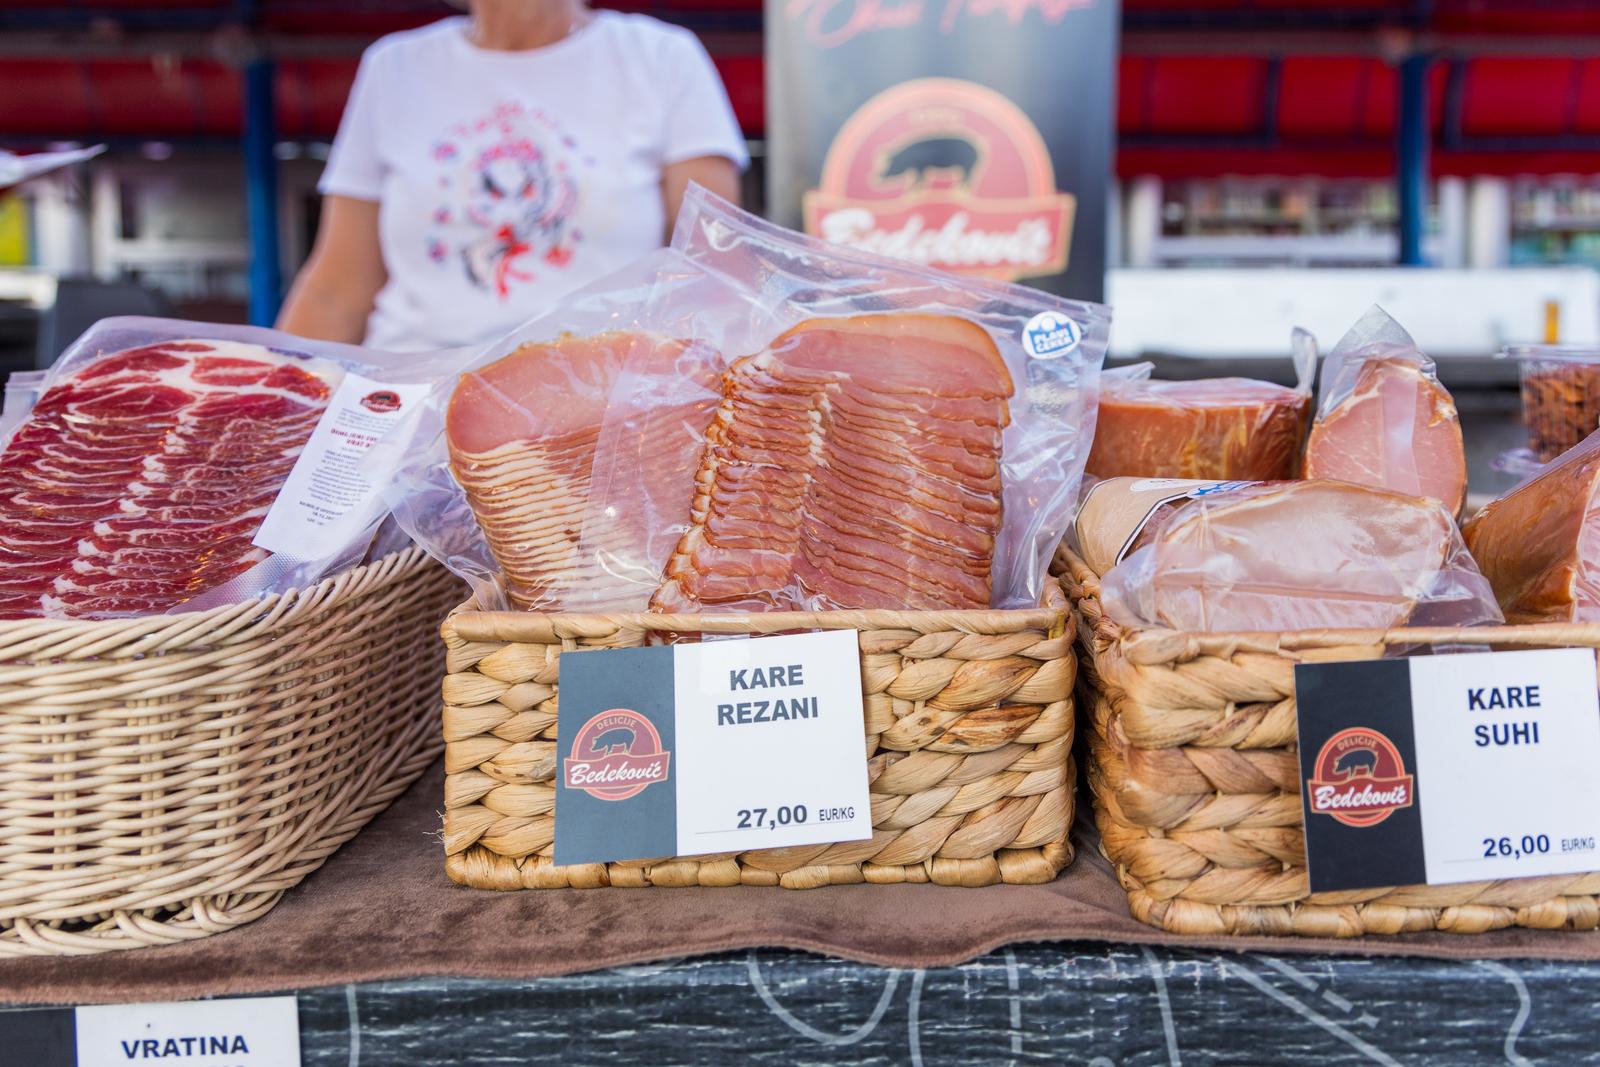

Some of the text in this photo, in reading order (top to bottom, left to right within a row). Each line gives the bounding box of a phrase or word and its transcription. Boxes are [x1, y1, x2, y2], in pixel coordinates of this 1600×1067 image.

[729, 664, 804, 692] KARE
[717, 696, 819, 726] REZANI
[1468, 685, 1541, 711] KARE
[596, 716, 637, 730] DELICIJE
[1474, 722, 1540, 747] SUHI
[1337, 735, 1378, 751] DELICIJE
[570, 761, 662, 785] Bedeković
[1315, 784, 1407, 810] Bedeković
[736, 805, 855, 831] 27,00 EUR/KG
[1483, 834, 1595, 860] 26,00 EUR/KG
[121, 1035, 249, 1059] VRATINA
